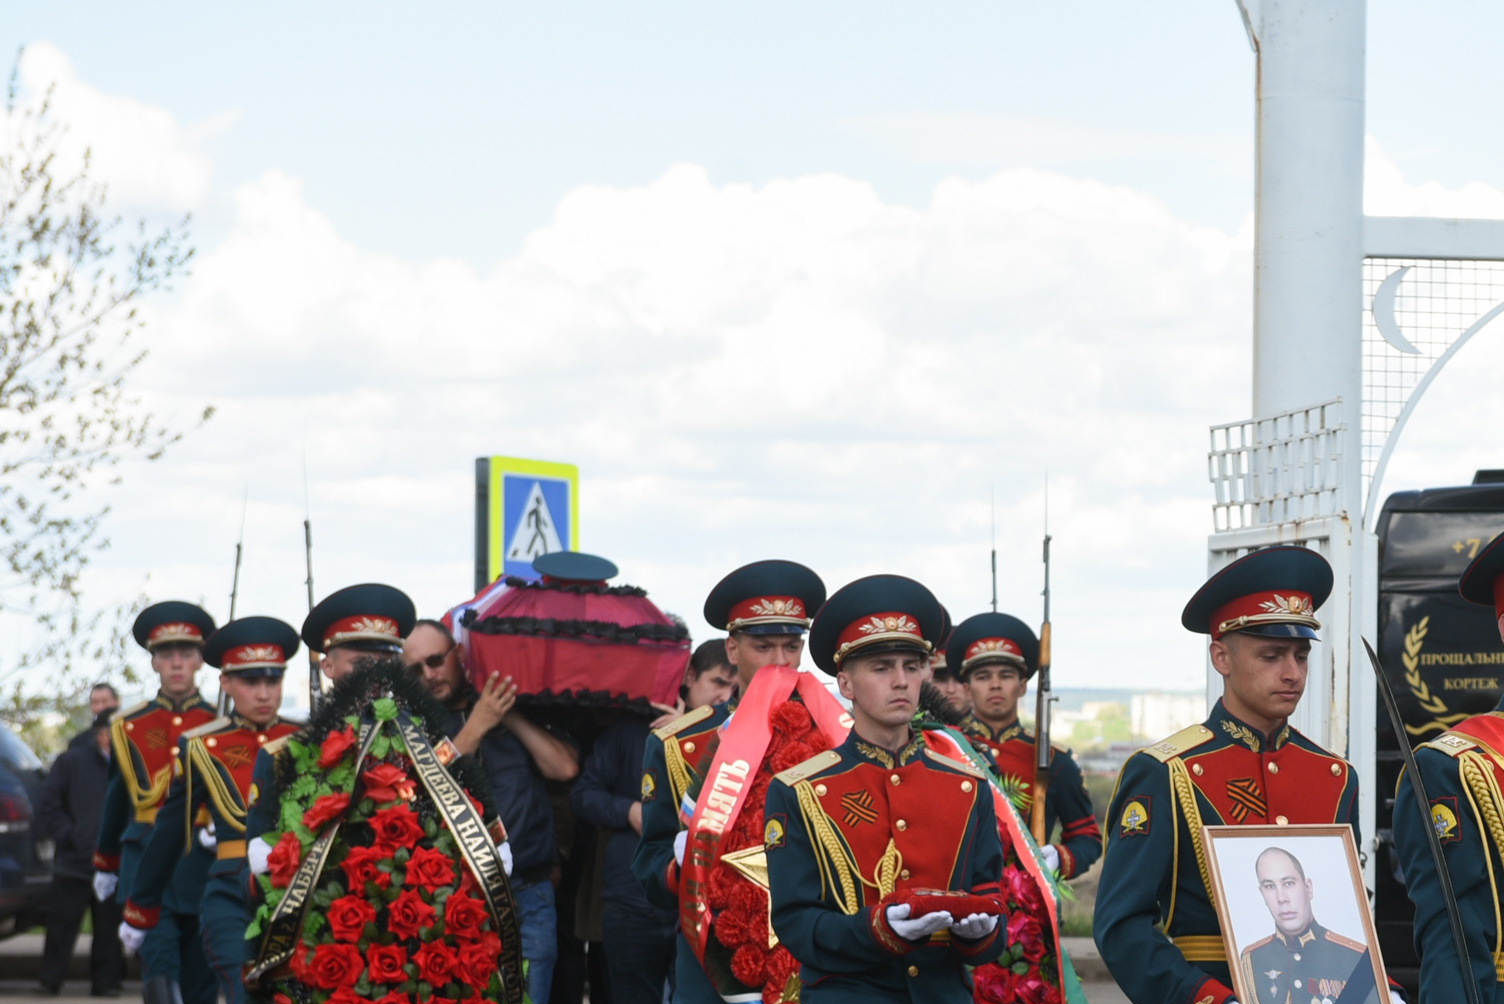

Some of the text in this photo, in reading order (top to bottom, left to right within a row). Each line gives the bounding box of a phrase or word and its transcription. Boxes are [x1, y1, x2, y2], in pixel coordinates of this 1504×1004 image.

[1452, 538, 1481, 558] +7
[1443, 677, 1499, 690] КОРТЕЖ
[403, 723, 468, 820] МАГДЕЕВА
[457, 817, 504, 891] НАИЛЯ
[690, 759, 750, 868] ПАМЯТЬ
[282, 837, 328, 915] НАБЕРЕ
